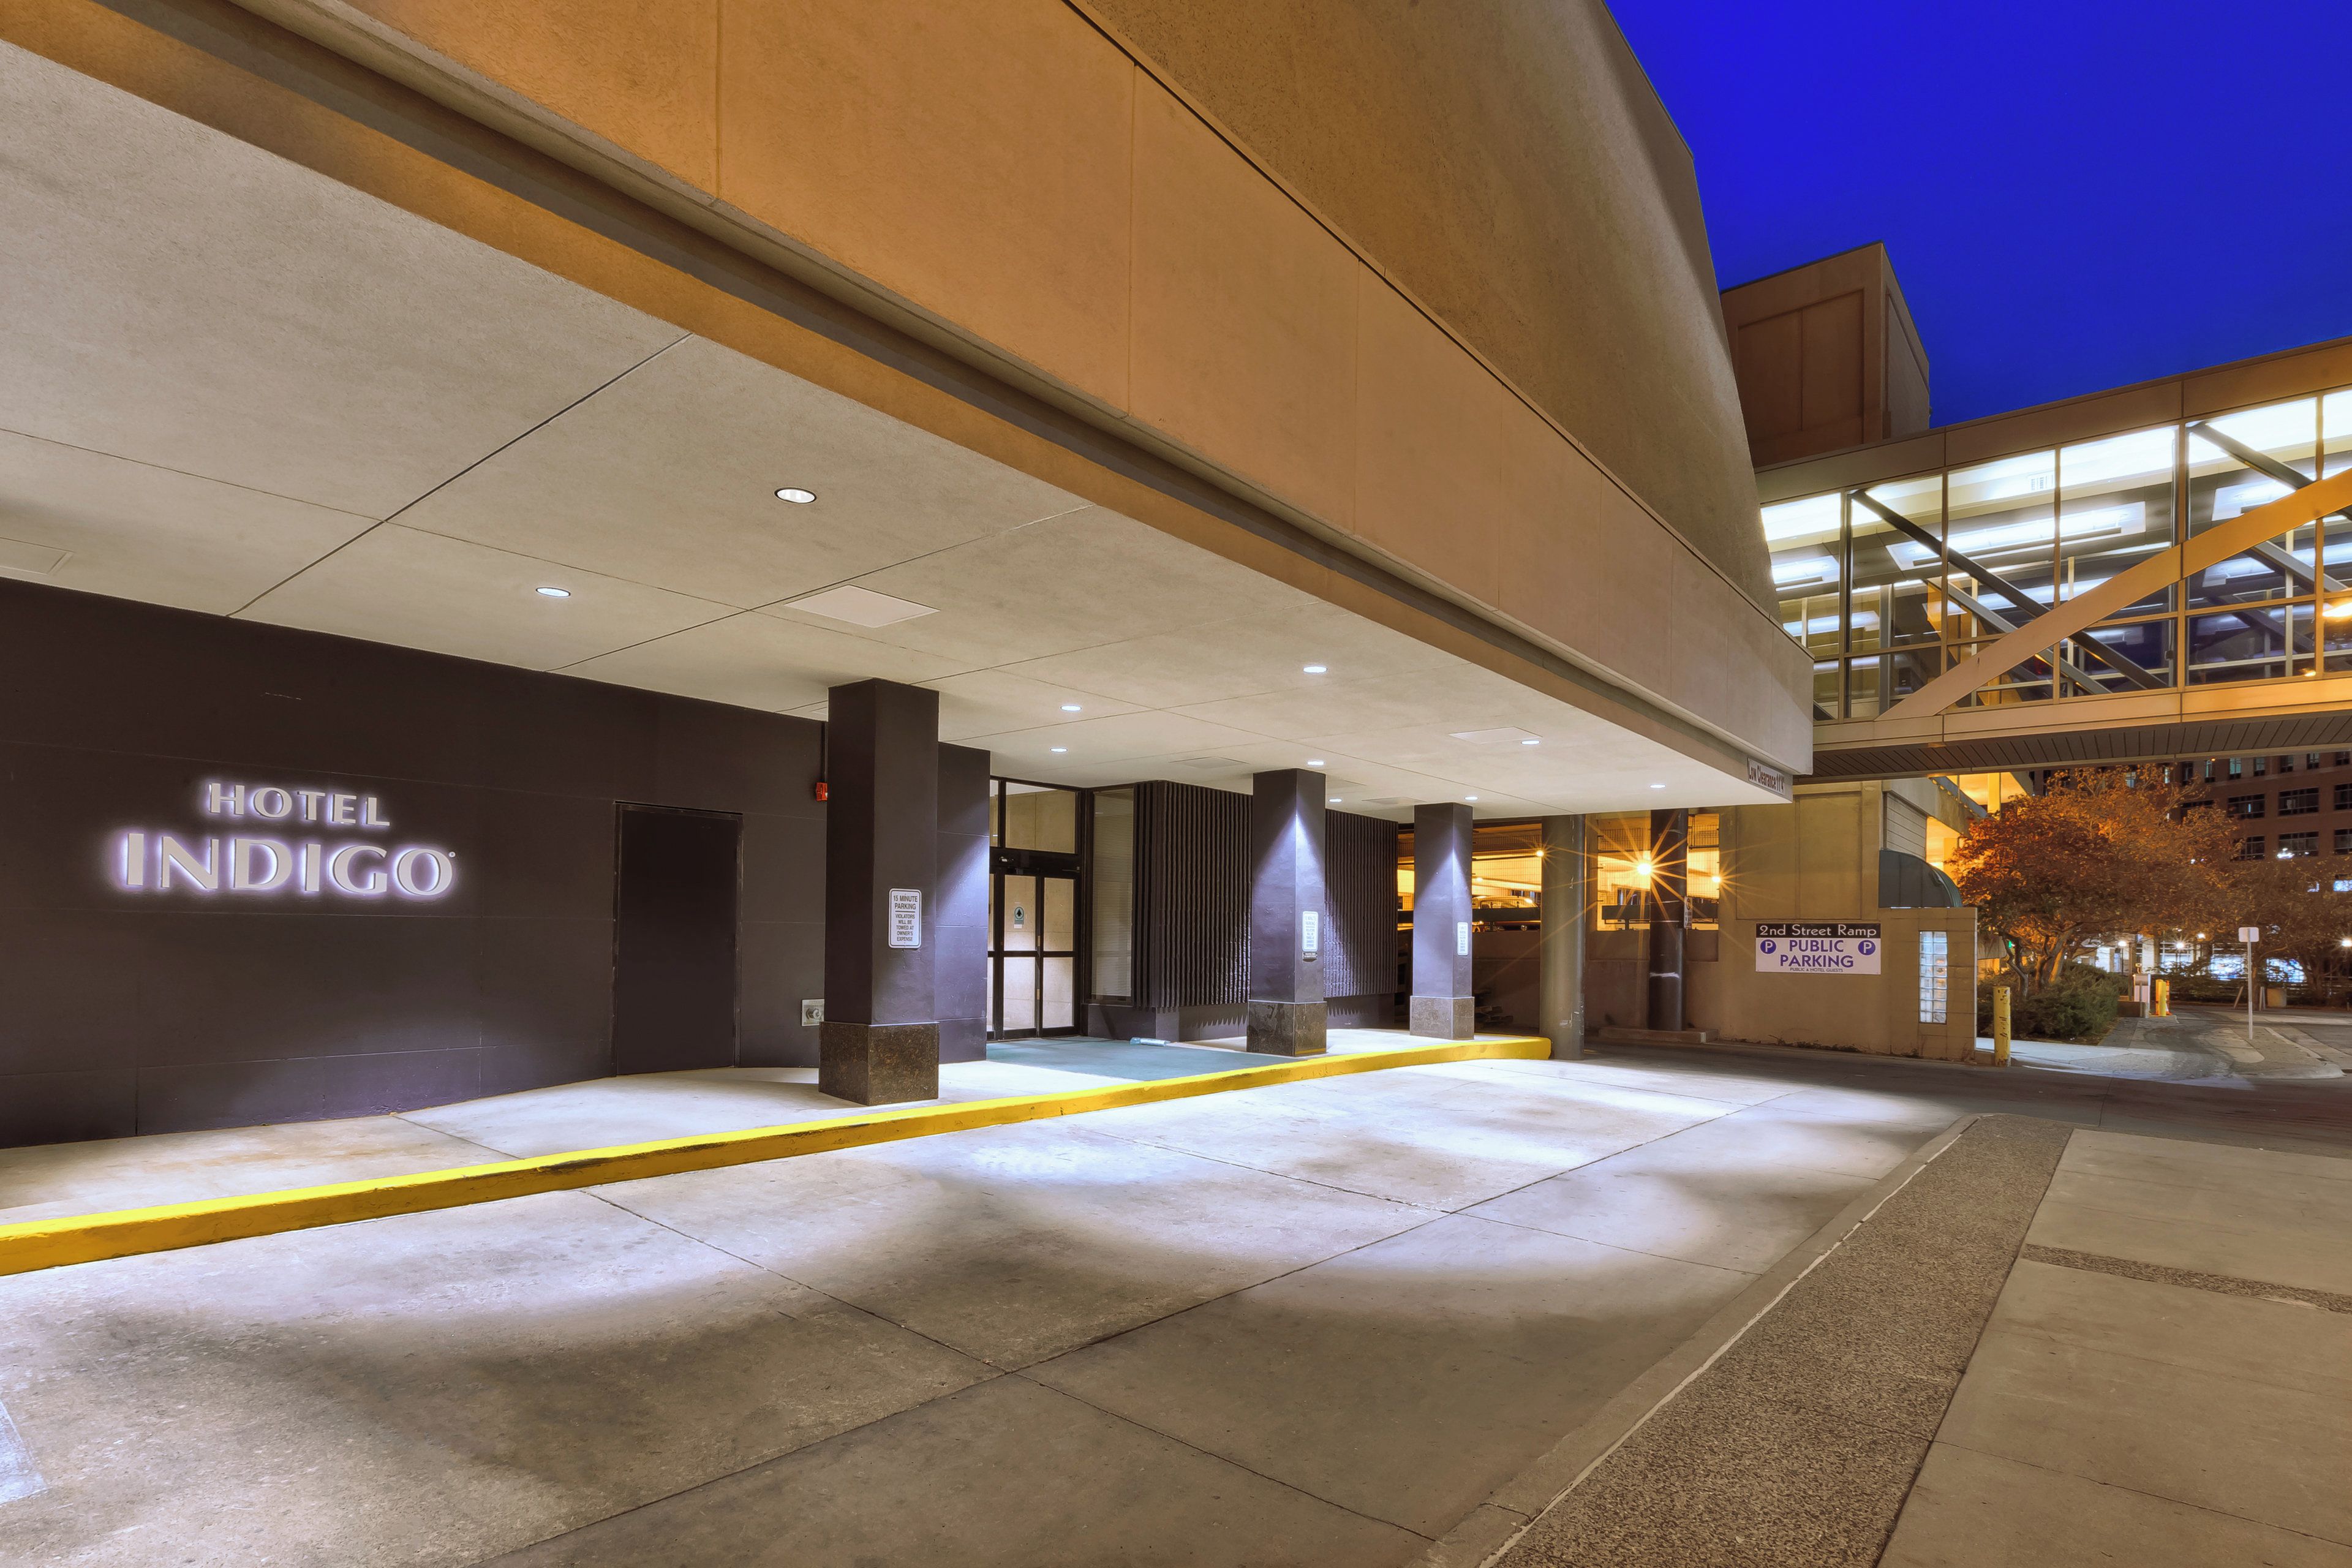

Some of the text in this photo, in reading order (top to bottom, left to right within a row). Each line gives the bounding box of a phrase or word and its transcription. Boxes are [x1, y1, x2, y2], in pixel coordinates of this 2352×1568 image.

[1757, 765, 1776, 790] Clearance
[209, 783, 390, 826] HOTEL
[126, 833, 453, 895] INDIGO
[1760, 924, 1877, 938] 2nd Street Ramp
[1765, 941, 1773, 952] P
[1789, 940, 1844, 952] PUBLIC
[1863, 942, 1872, 953] P
[1780, 954, 1853, 968] PARKING
